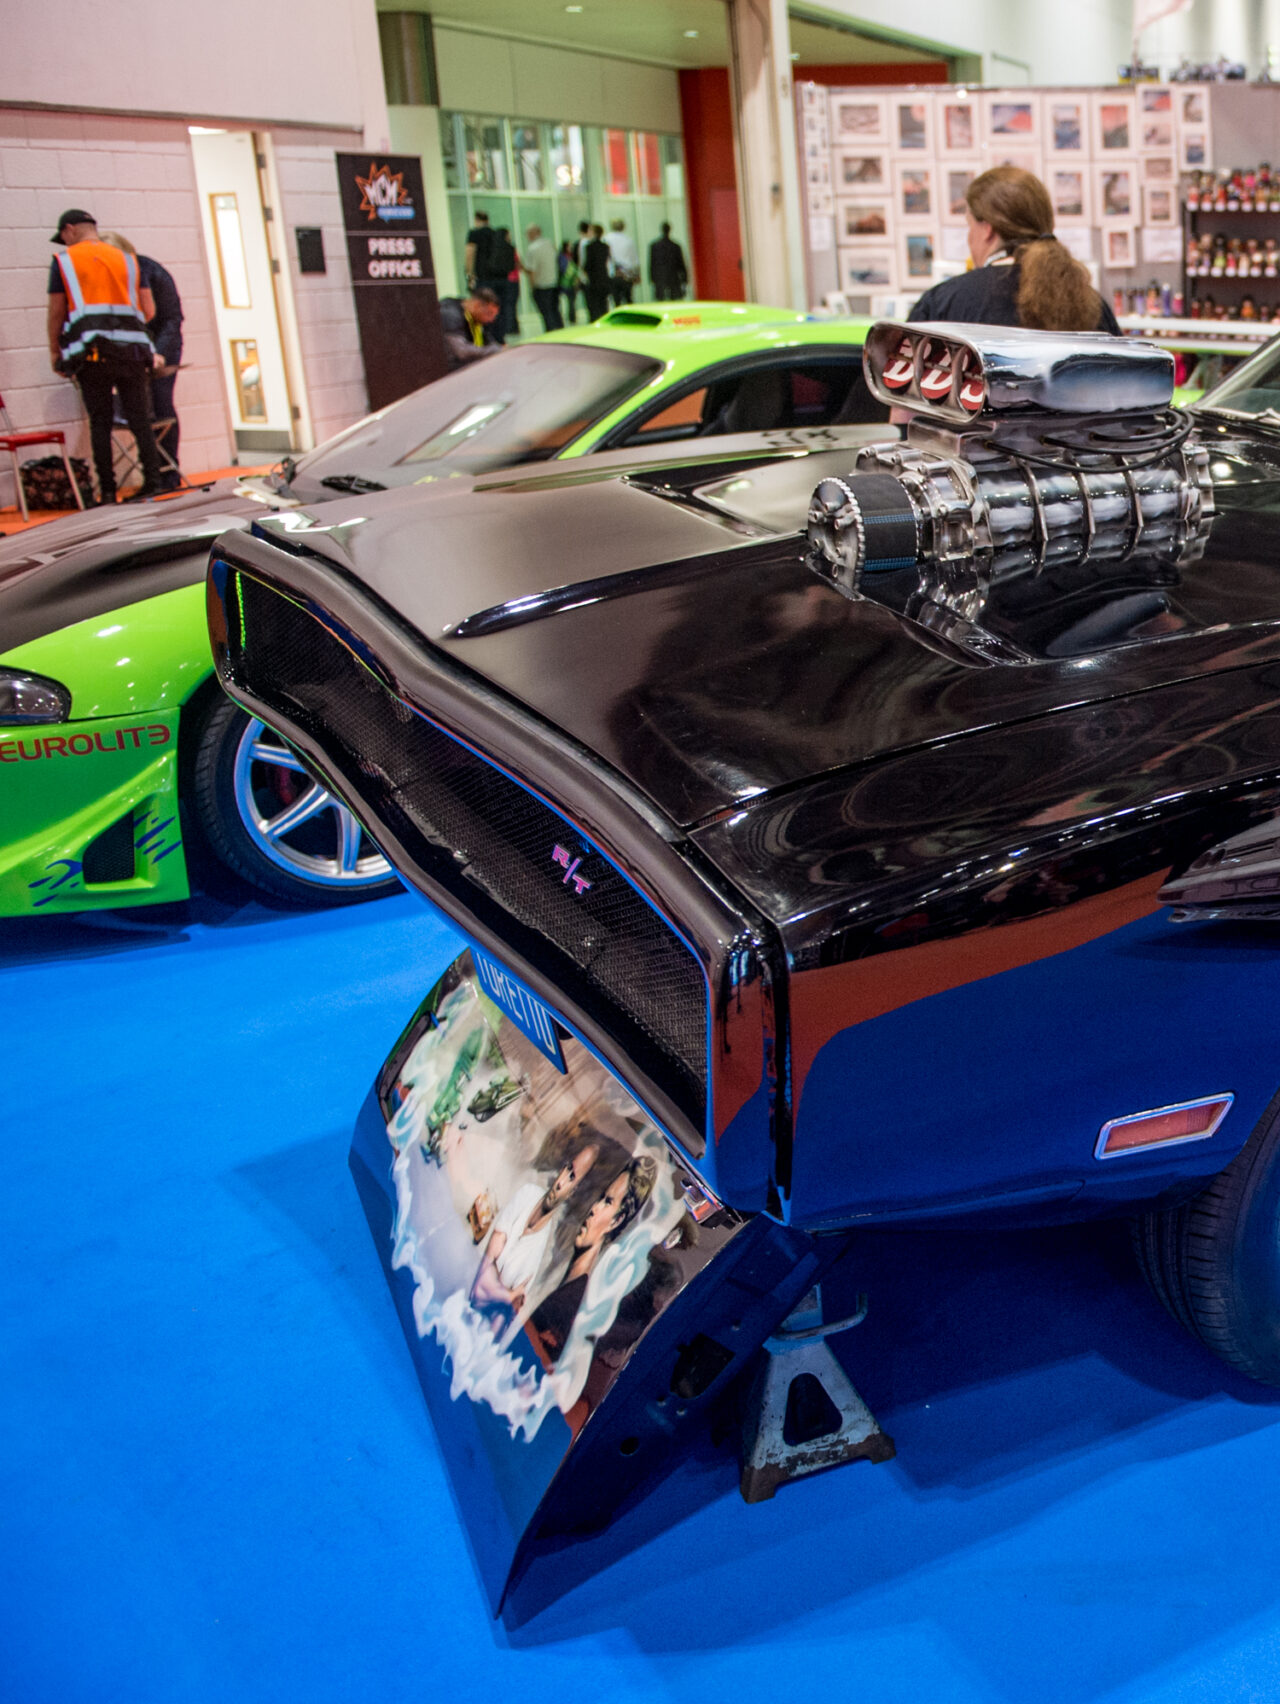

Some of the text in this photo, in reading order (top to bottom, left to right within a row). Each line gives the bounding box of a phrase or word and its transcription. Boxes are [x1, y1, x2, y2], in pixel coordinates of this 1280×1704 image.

[365, 173, 398, 206] MCM
[368, 238, 415, 256] PRESS
[368, 260, 422, 278] OFFICE
[552, 844, 590, 894] R/T
